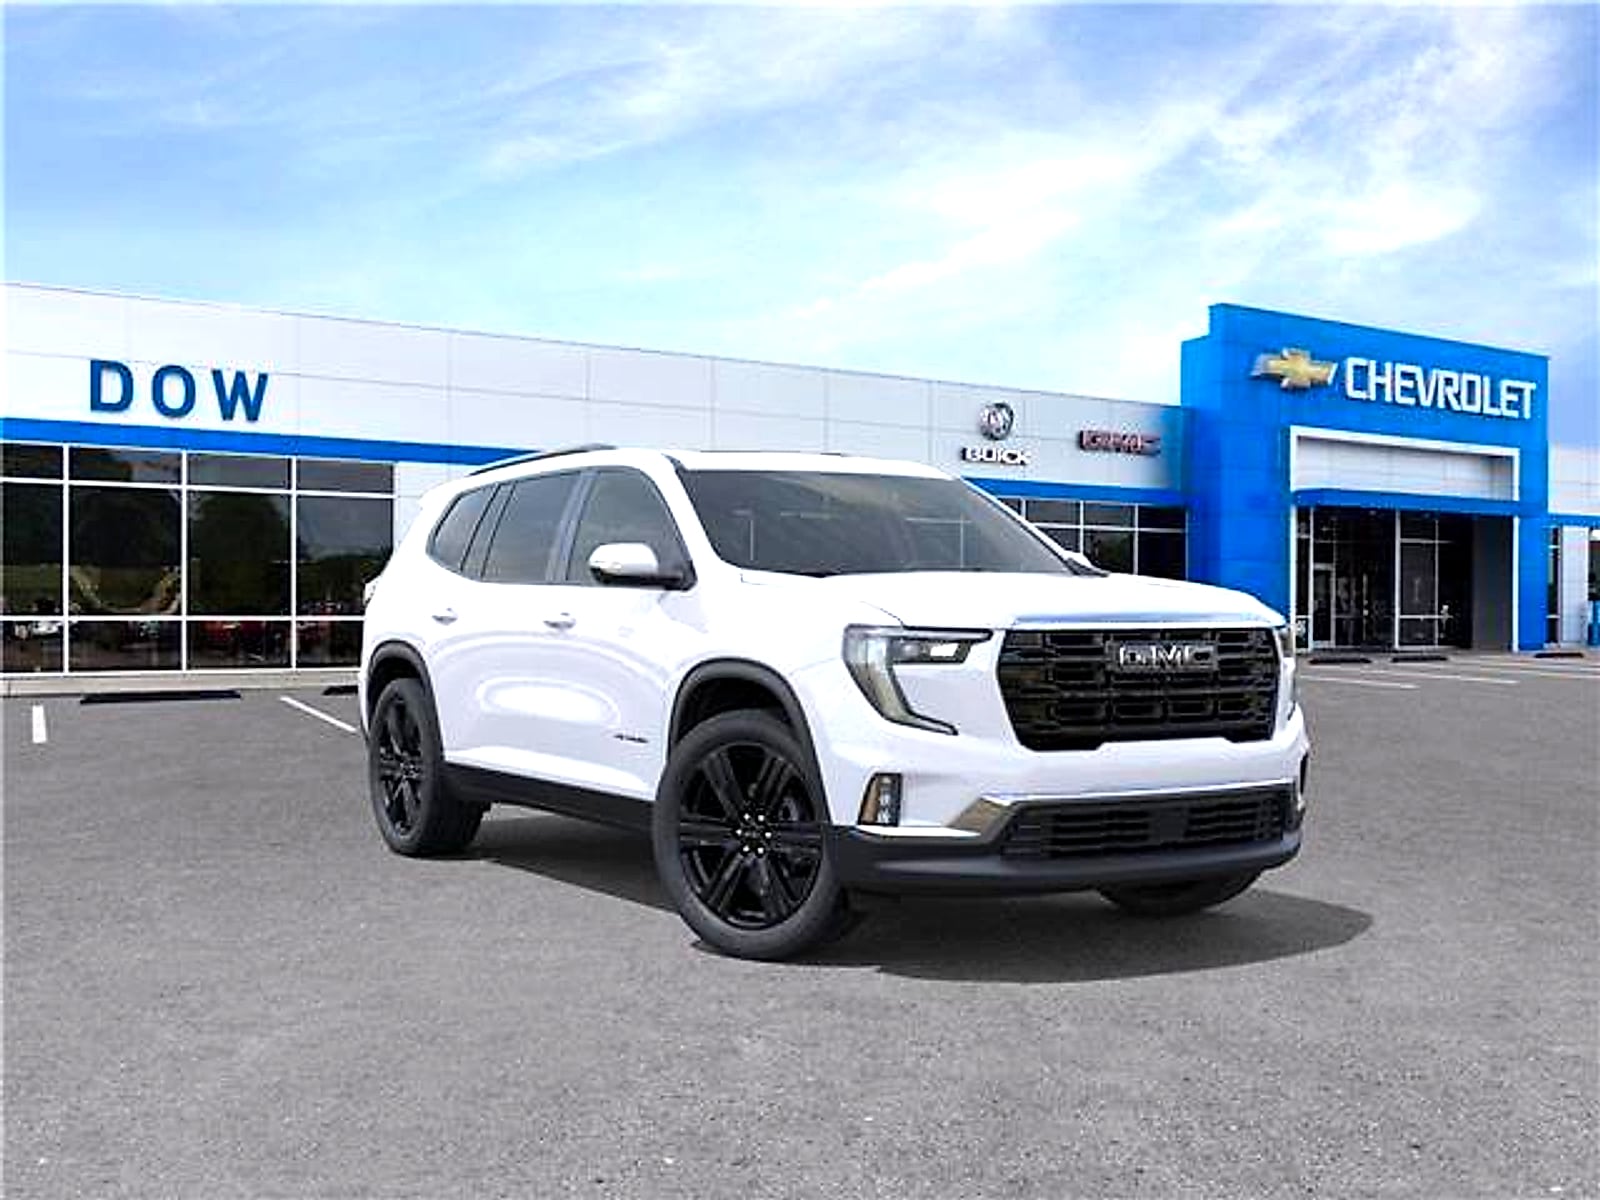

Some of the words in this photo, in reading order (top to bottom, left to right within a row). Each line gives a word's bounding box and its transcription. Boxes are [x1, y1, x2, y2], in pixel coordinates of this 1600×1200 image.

[90, 359, 268, 421] DOW
[1345, 356, 1537, 419] CHEVROLET
[961, 446, 1031, 466] BUICK
[1116, 643, 1217, 673] GMC
